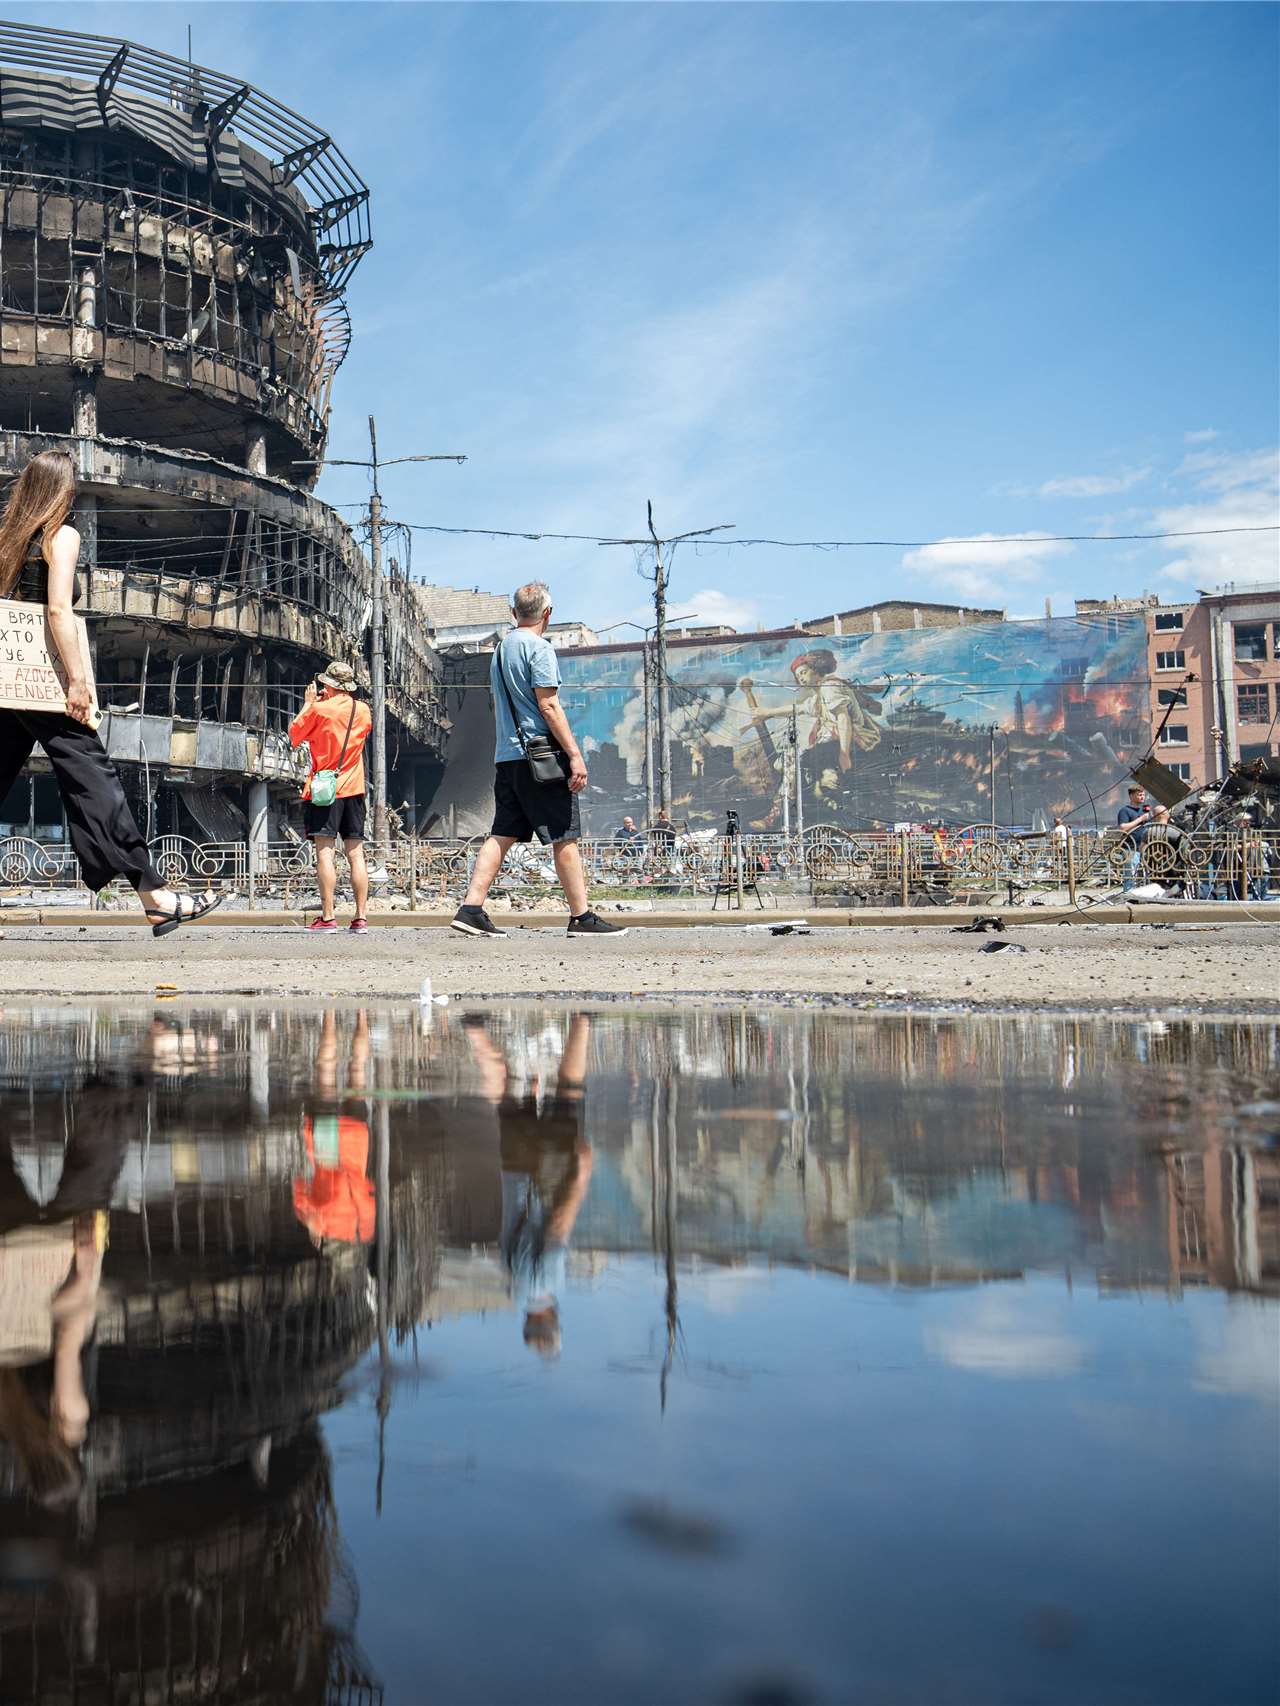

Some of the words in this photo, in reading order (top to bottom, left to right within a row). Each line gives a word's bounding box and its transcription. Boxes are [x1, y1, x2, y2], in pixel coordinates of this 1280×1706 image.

[8, 611, 44, 626] ВРЯТ
[0, 628, 34, 644] ХТО
[15, 667, 65, 685] AZOVST
